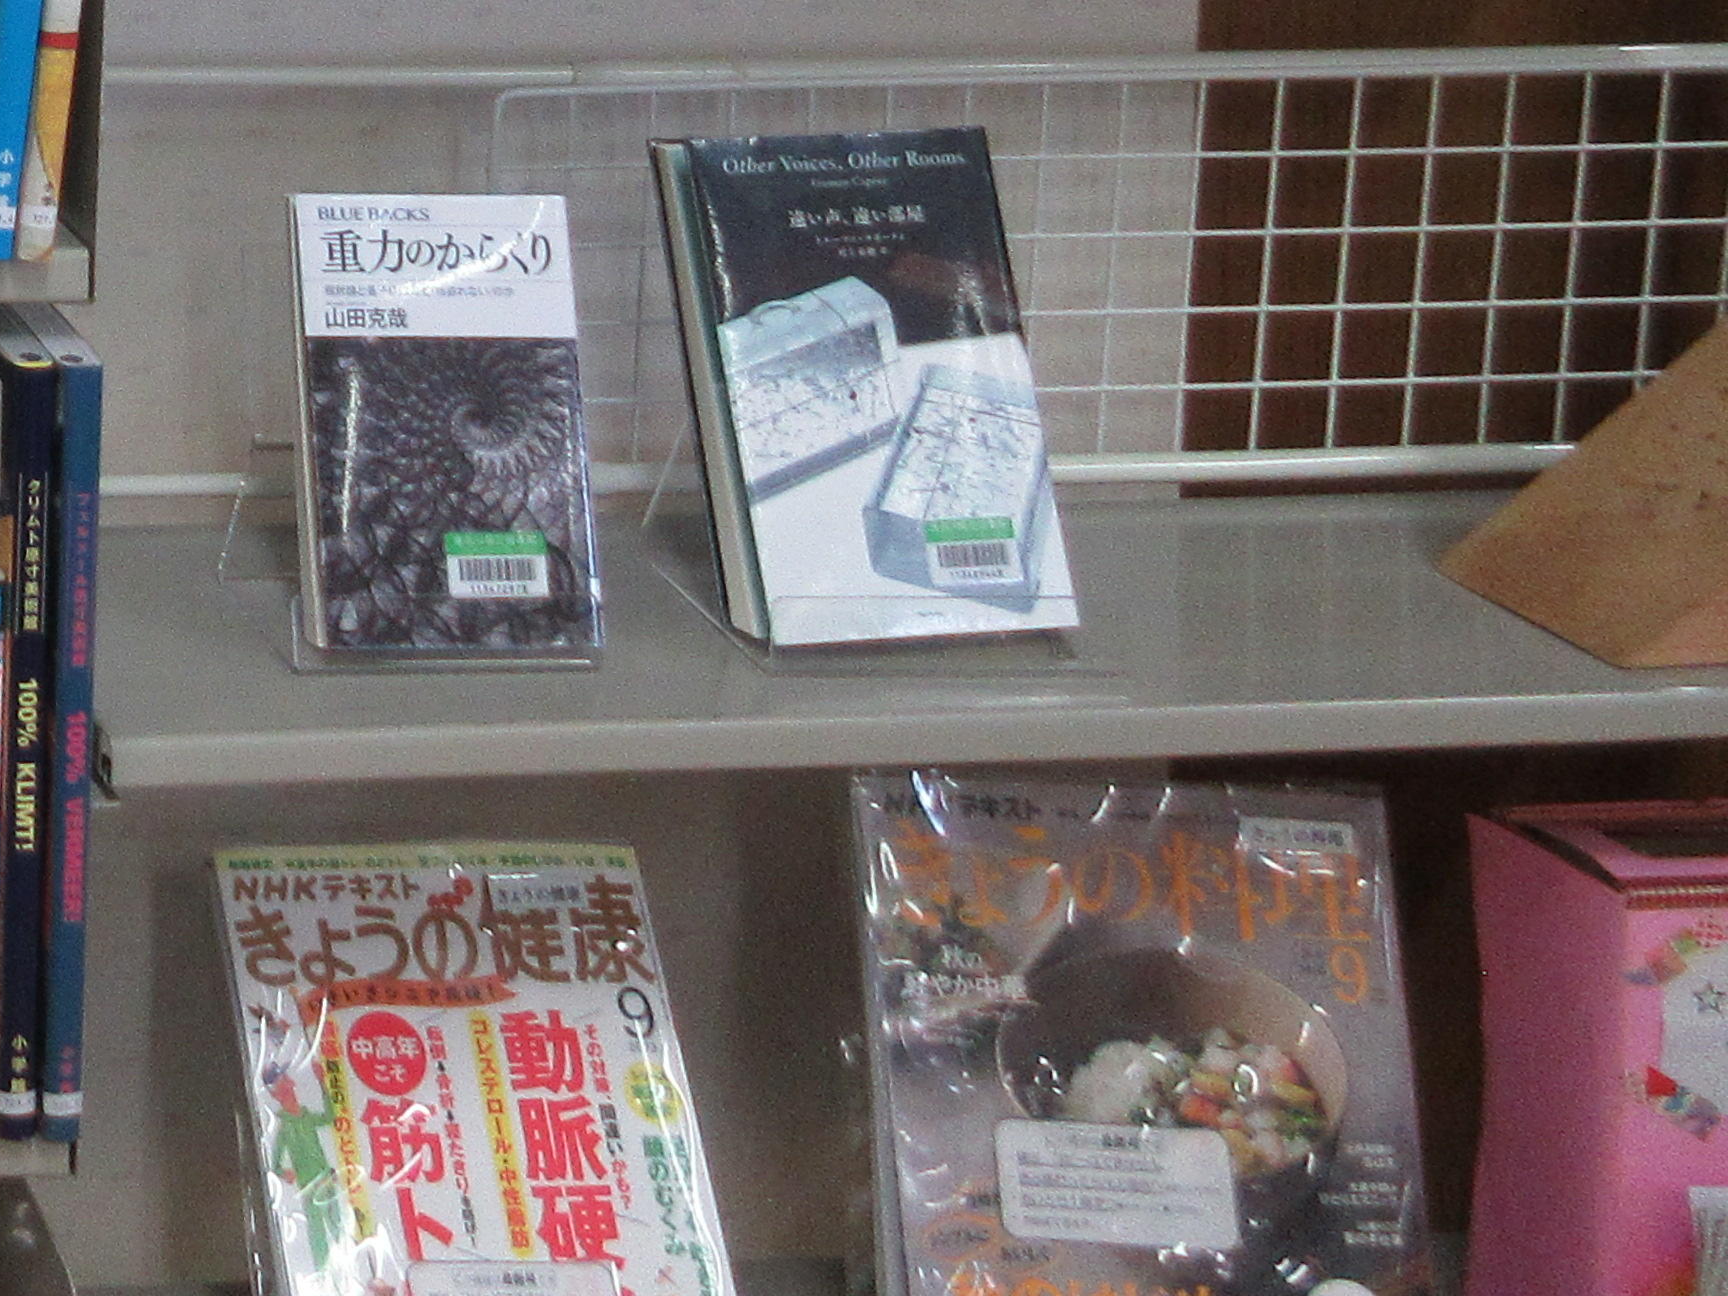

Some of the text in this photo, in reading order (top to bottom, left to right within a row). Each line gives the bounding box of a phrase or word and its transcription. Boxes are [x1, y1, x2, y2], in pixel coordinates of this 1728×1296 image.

[723, 149, 965, 174] Other Other Rooms
[318, 207, 430, 221] BLUE BACKS
[321, 229, 551, 274] 重力のからくり
[325, 308, 407, 328] 山田克哉
[15, 479, 40, 853] クリムト原寸美術館 100% KLIMT!
[234, 875, 420, 901] NHKテキスト
[1329, 946, 1370, 1001] 9
[617, 987, 654, 1038] 9
[352, 1036, 420, 1058] 中高年
[374, 1065, 404, 1083] こそ
